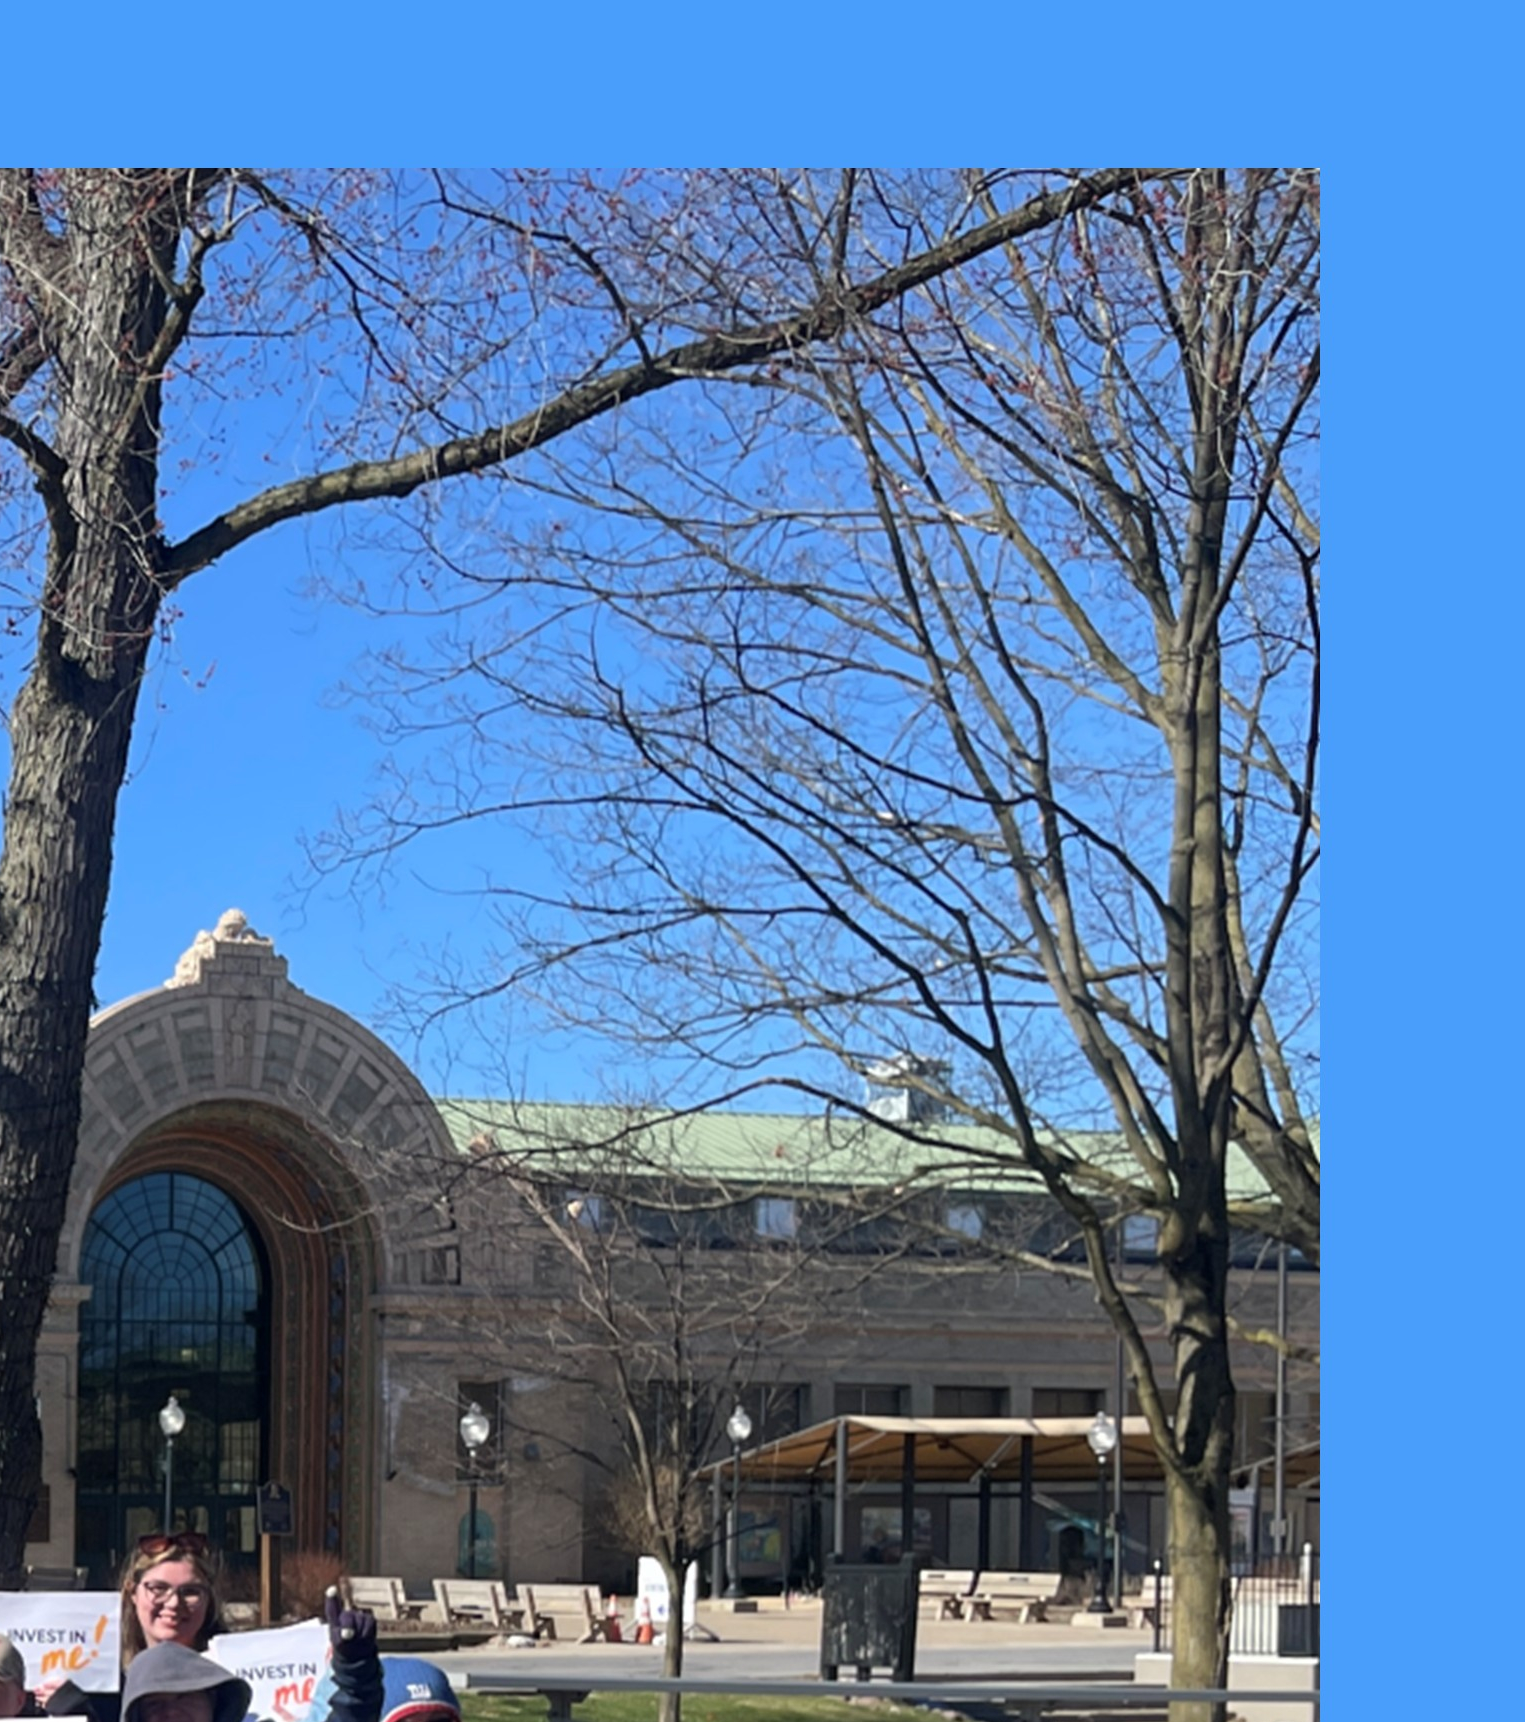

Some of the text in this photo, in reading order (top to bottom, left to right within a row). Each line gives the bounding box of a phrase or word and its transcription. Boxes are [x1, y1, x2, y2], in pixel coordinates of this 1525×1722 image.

[7, 1628, 86, 1644] INVEST IN
[40, 1613, 109, 1675] me!
[235, 1662, 317, 1681] INVEST IN
